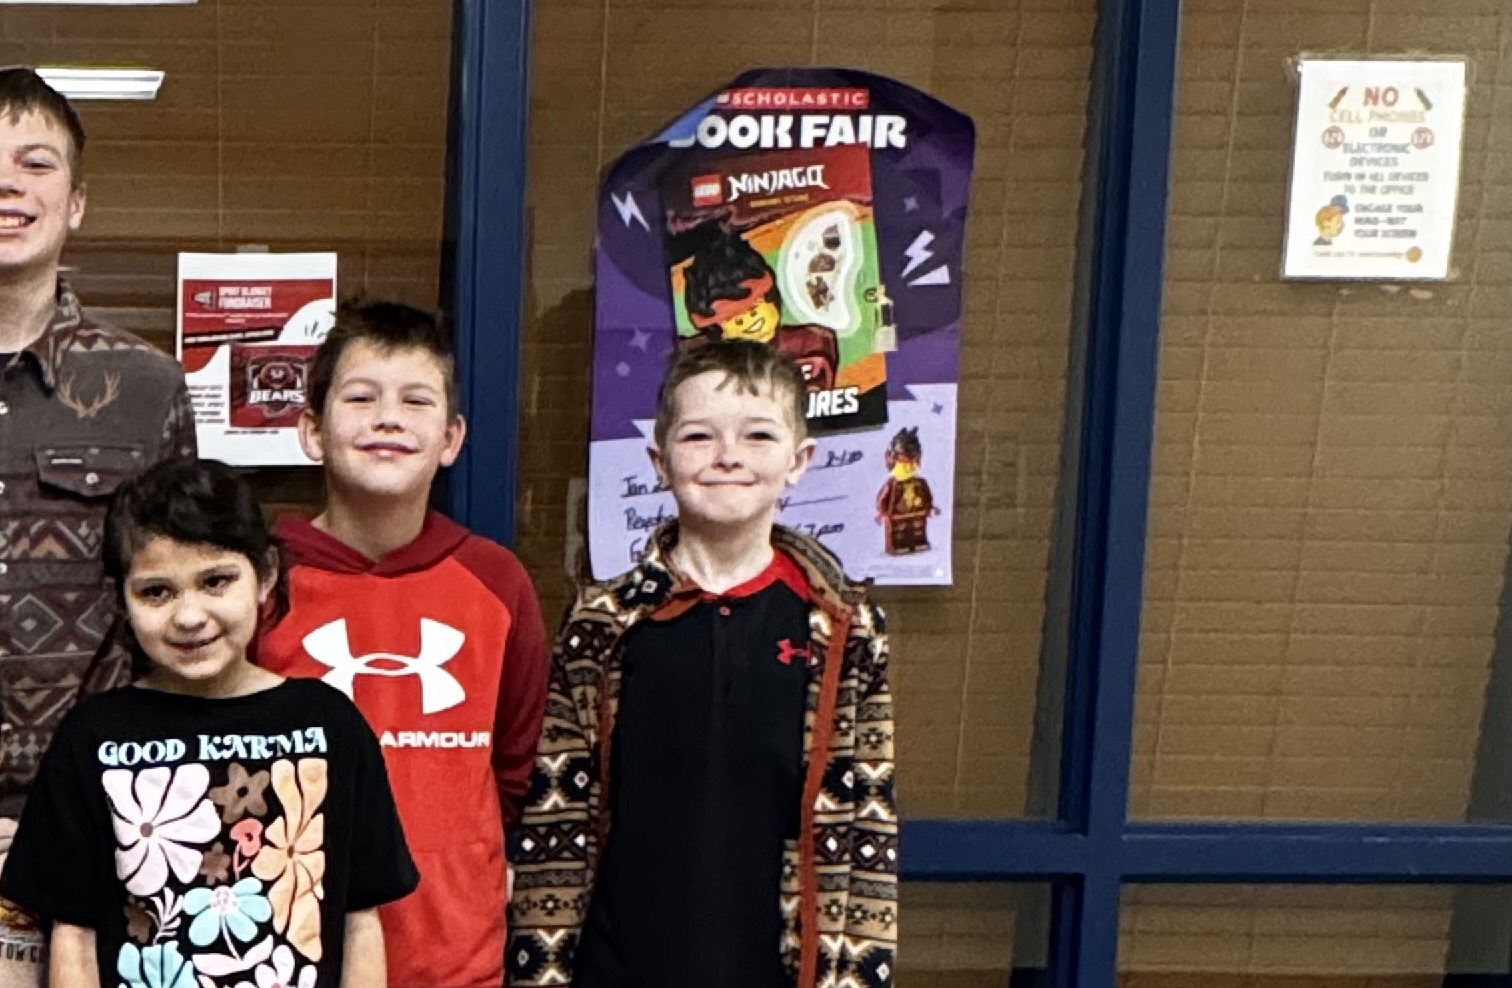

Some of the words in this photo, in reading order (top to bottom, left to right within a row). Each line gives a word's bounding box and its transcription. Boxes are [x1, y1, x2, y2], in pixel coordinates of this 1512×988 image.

[732, 92, 865, 106] SCHOLASTIC
[1363, 86, 1399, 107] NO
[1330, 110, 1362, 124] CELL
[669, 114, 793, 148] OOK
[800, 114, 907, 148] FAIR
[1349, 157, 1399, 168] DEVICES
[727, 165, 830, 201] NINJAGO
[249, 390, 305, 403] BEARS
[97, 738, 187, 766] GOOD
[196, 727, 328, 762] KARMA
[380, 731, 492, 748] ARMOUR
